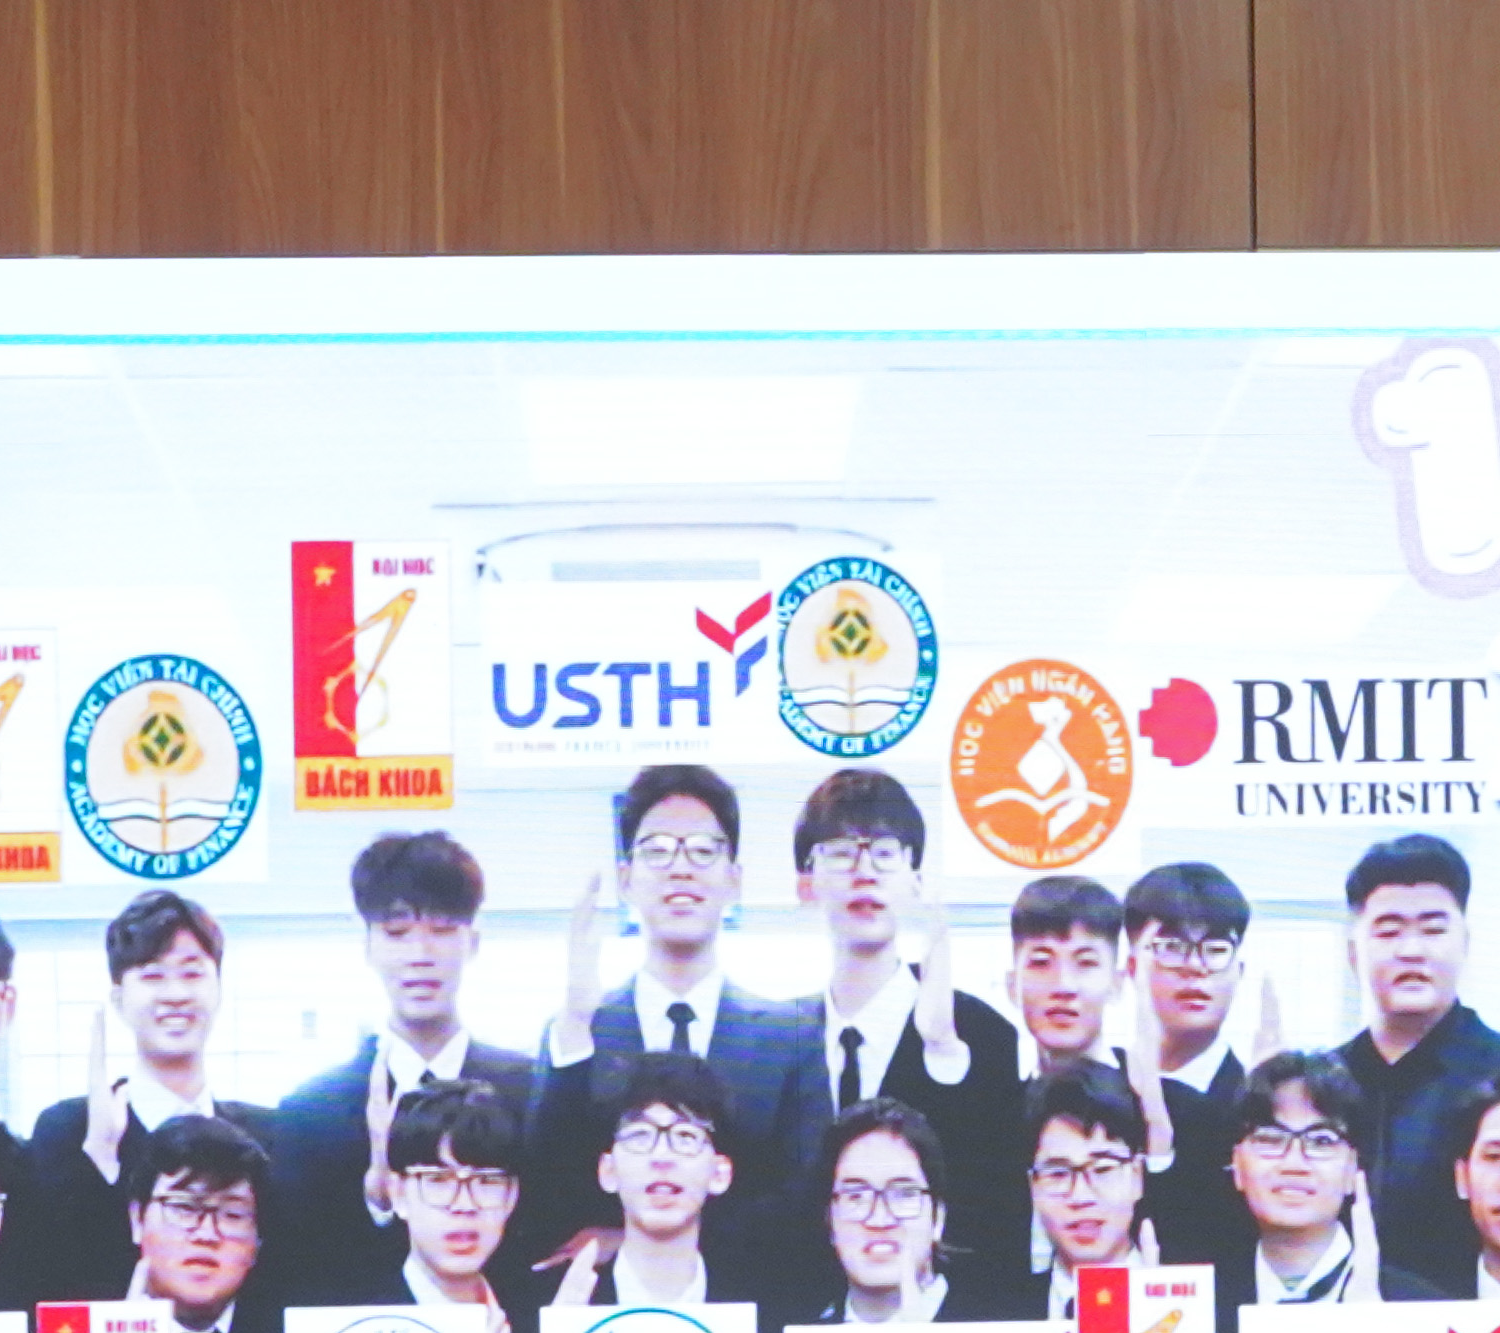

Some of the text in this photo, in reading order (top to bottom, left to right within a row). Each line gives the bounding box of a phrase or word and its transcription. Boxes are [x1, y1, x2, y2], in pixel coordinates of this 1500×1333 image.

[492, 661, 711, 728] USTH
[1232, 678, 1488, 764] RMIT
[1235, 780, 1486, 816] UNIVERSITY
